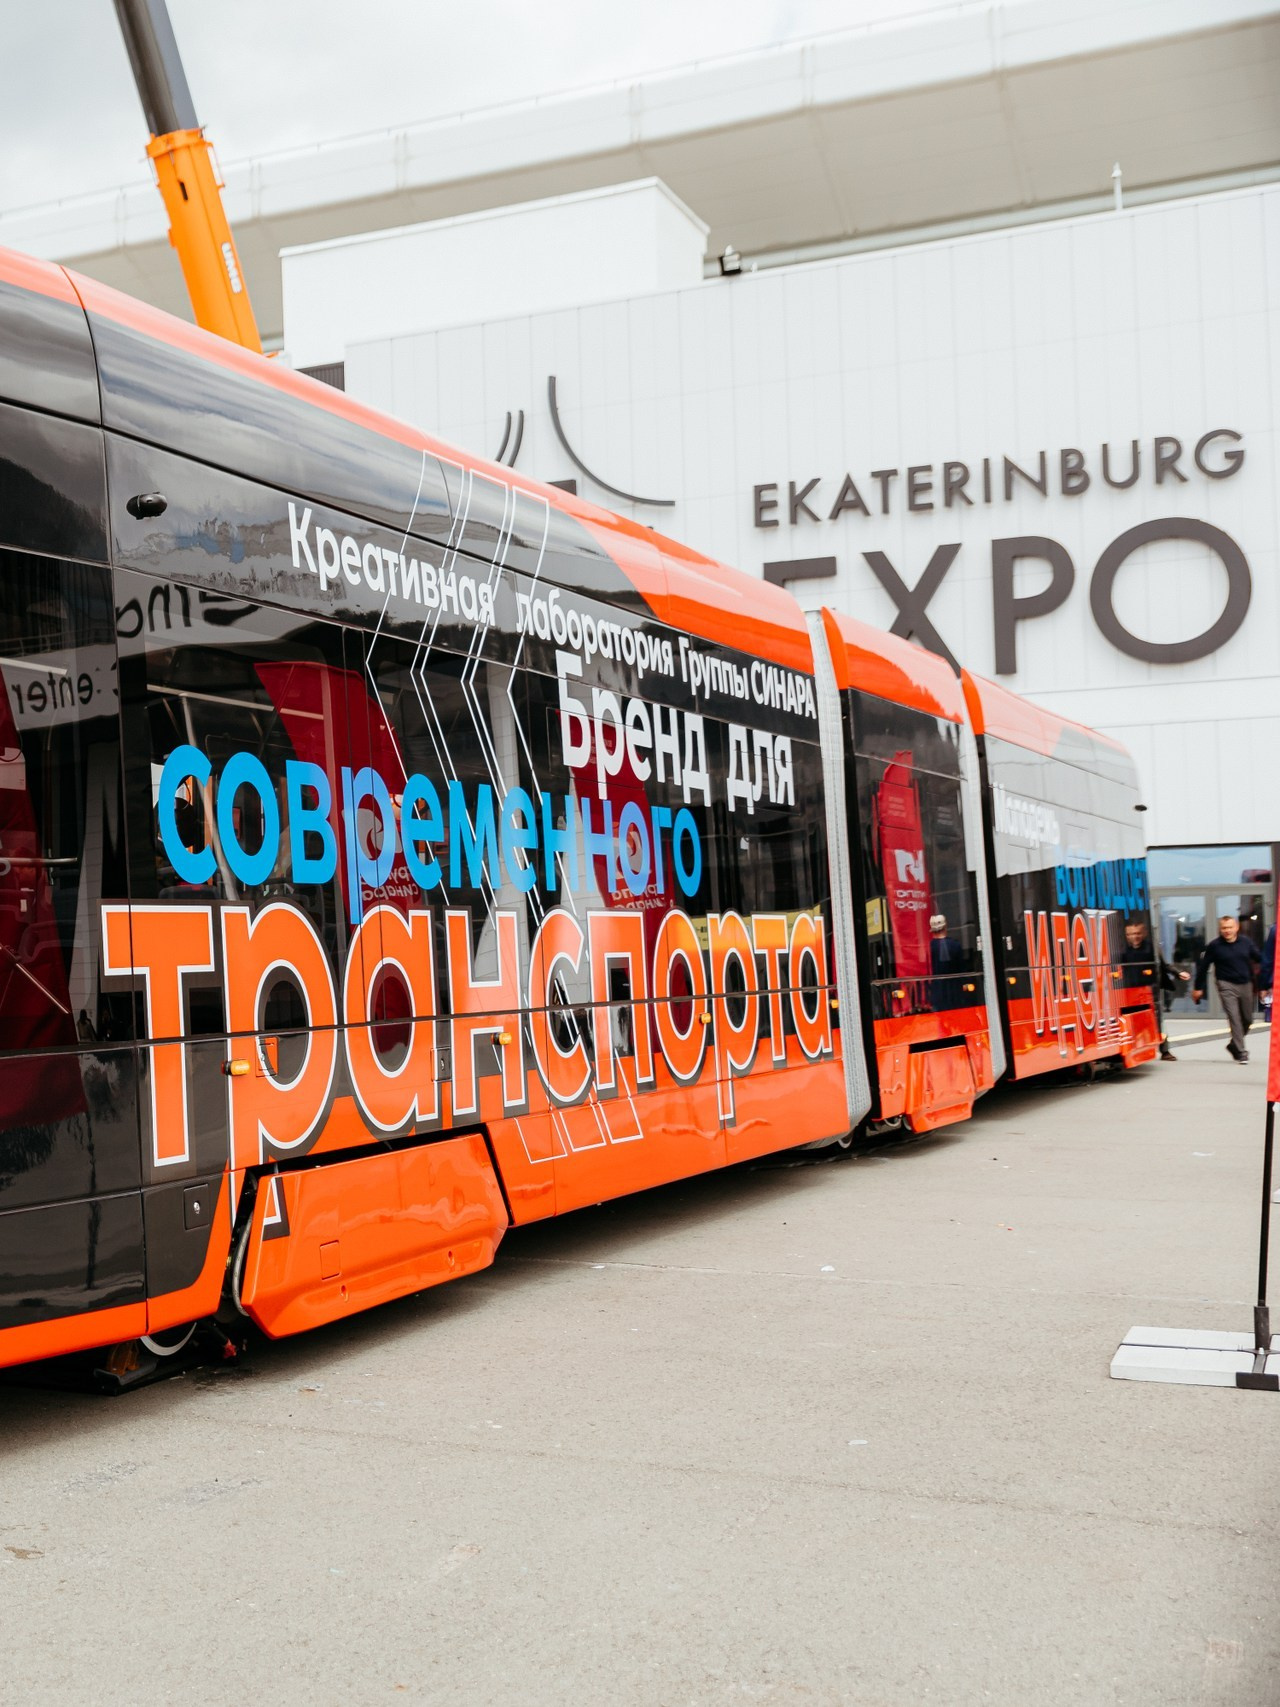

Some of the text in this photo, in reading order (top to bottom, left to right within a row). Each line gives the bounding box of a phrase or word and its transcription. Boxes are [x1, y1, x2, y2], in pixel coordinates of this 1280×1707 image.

[753, 429, 1246, 528] EKATERINBURG
[287, 501, 818, 720] Креативная лаборатория Группы СИНАРА
[555, 650, 796, 815] Бренд для
[158, 744, 702, 925] современного
[101, 901, 833, 1224] транспорта
